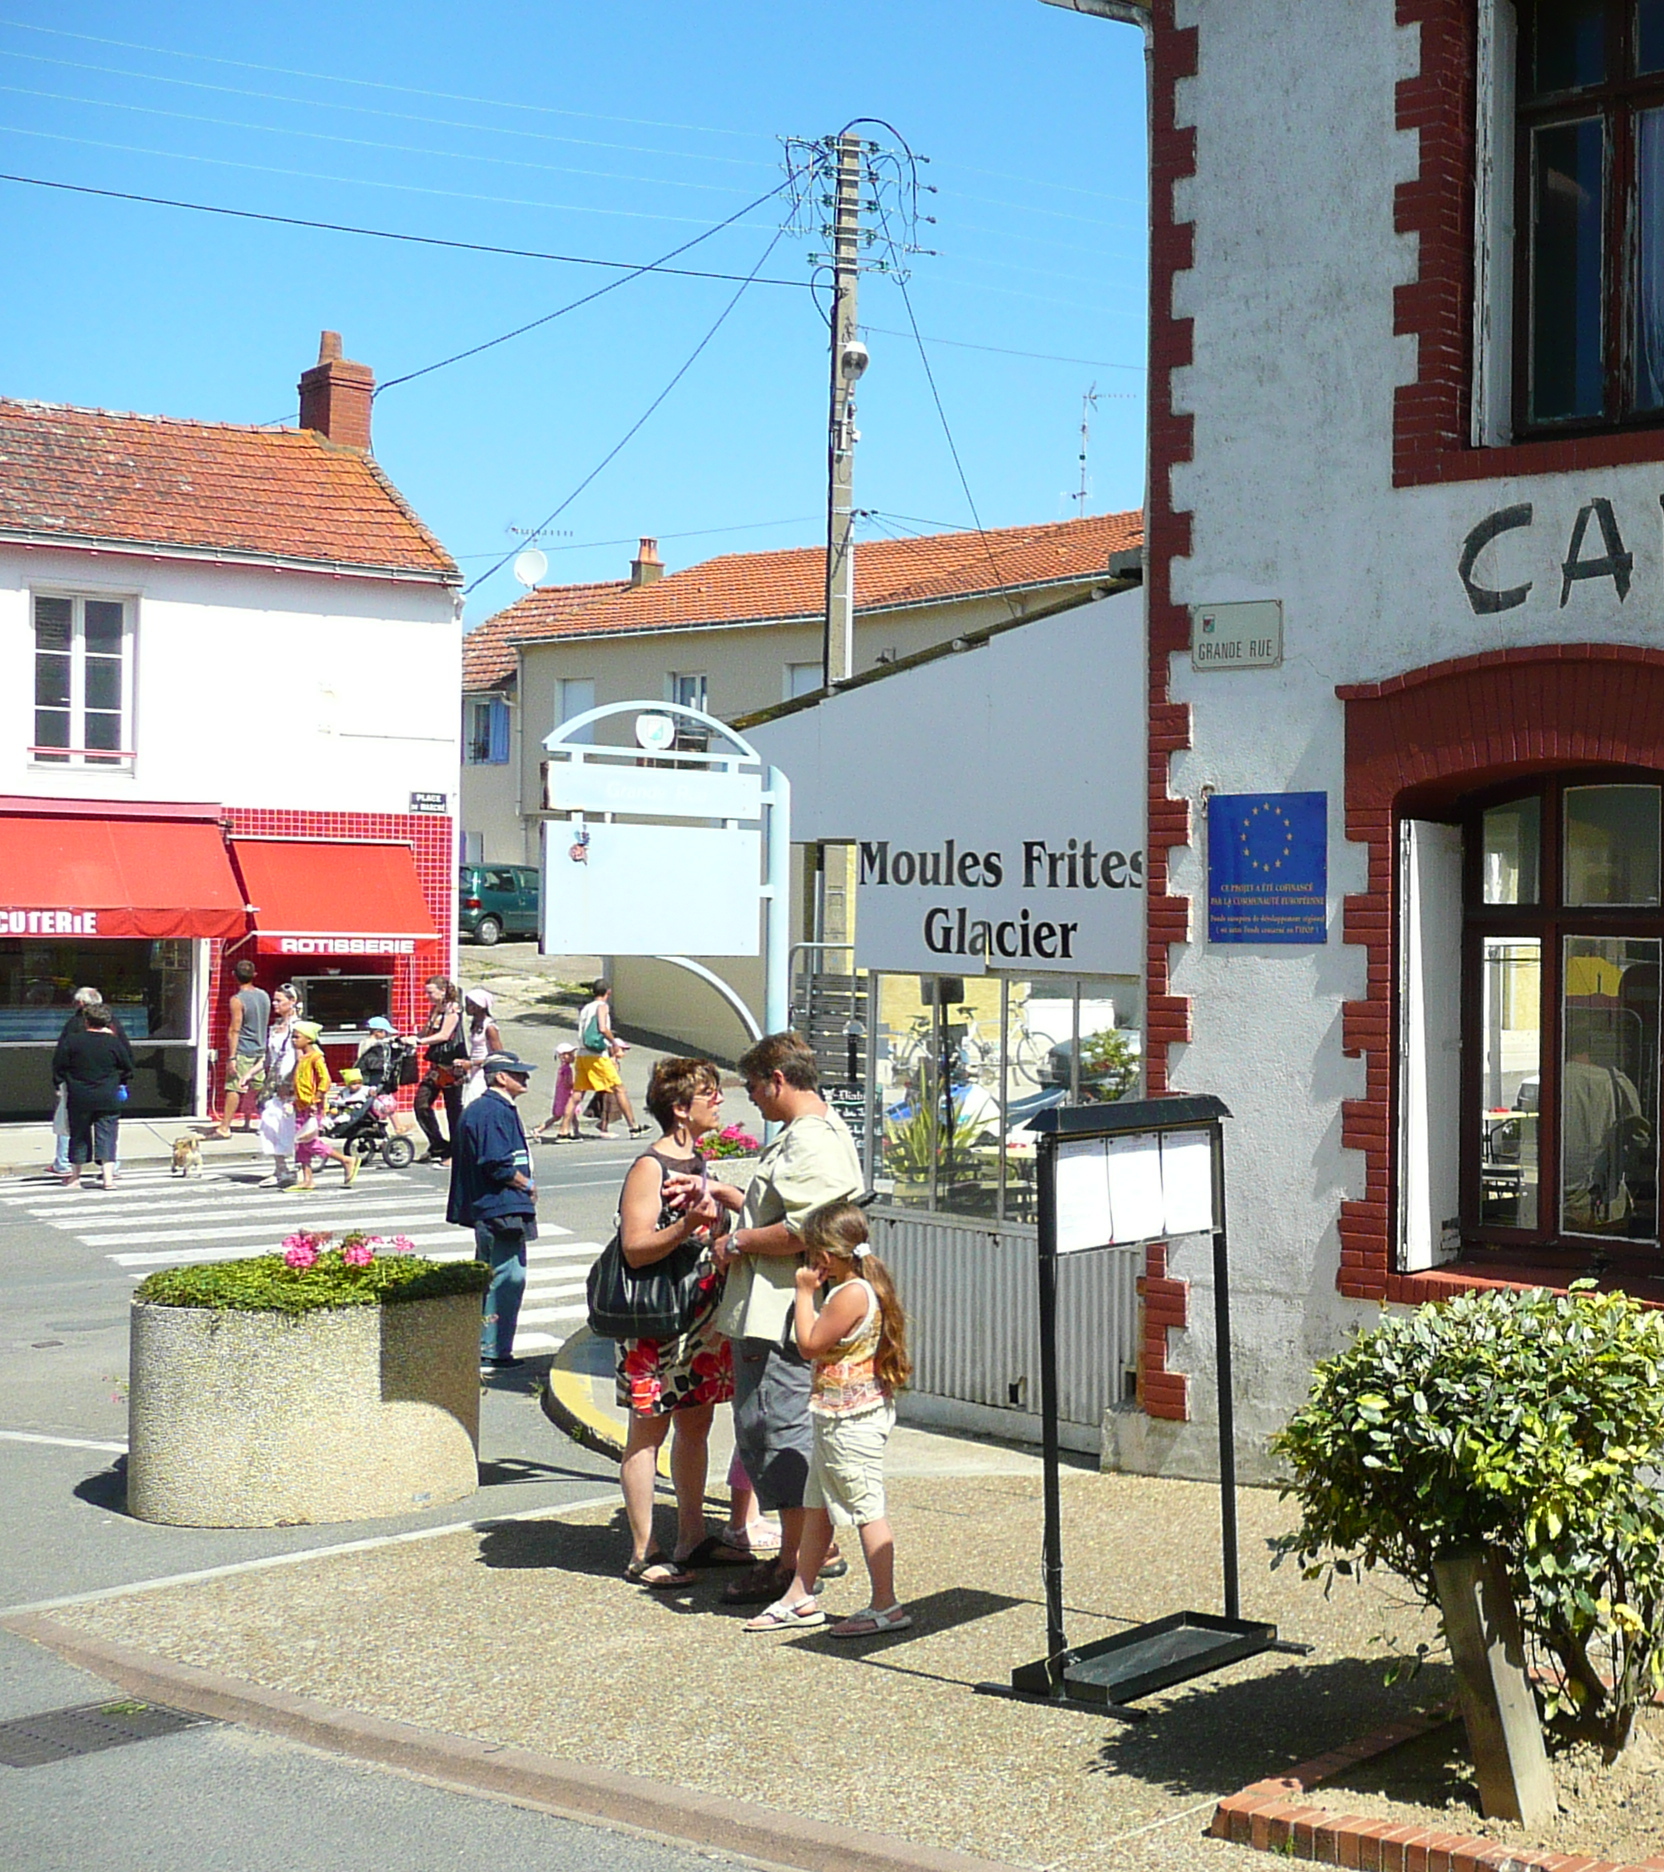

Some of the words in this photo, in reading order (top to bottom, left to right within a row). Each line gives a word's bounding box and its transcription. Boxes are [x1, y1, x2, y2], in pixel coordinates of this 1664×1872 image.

[1198, 641, 1242, 660] GRANDE
[1249, 639, 1272, 658] RUE
[416, 793, 441, 802] PLACE
[859, 839, 1003, 888] Moules
[1022, 838, 1143, 889] Frites
[923, 907, 1078, 959] Glacier
[281, 938, 415, 954] ROTISSERIE
